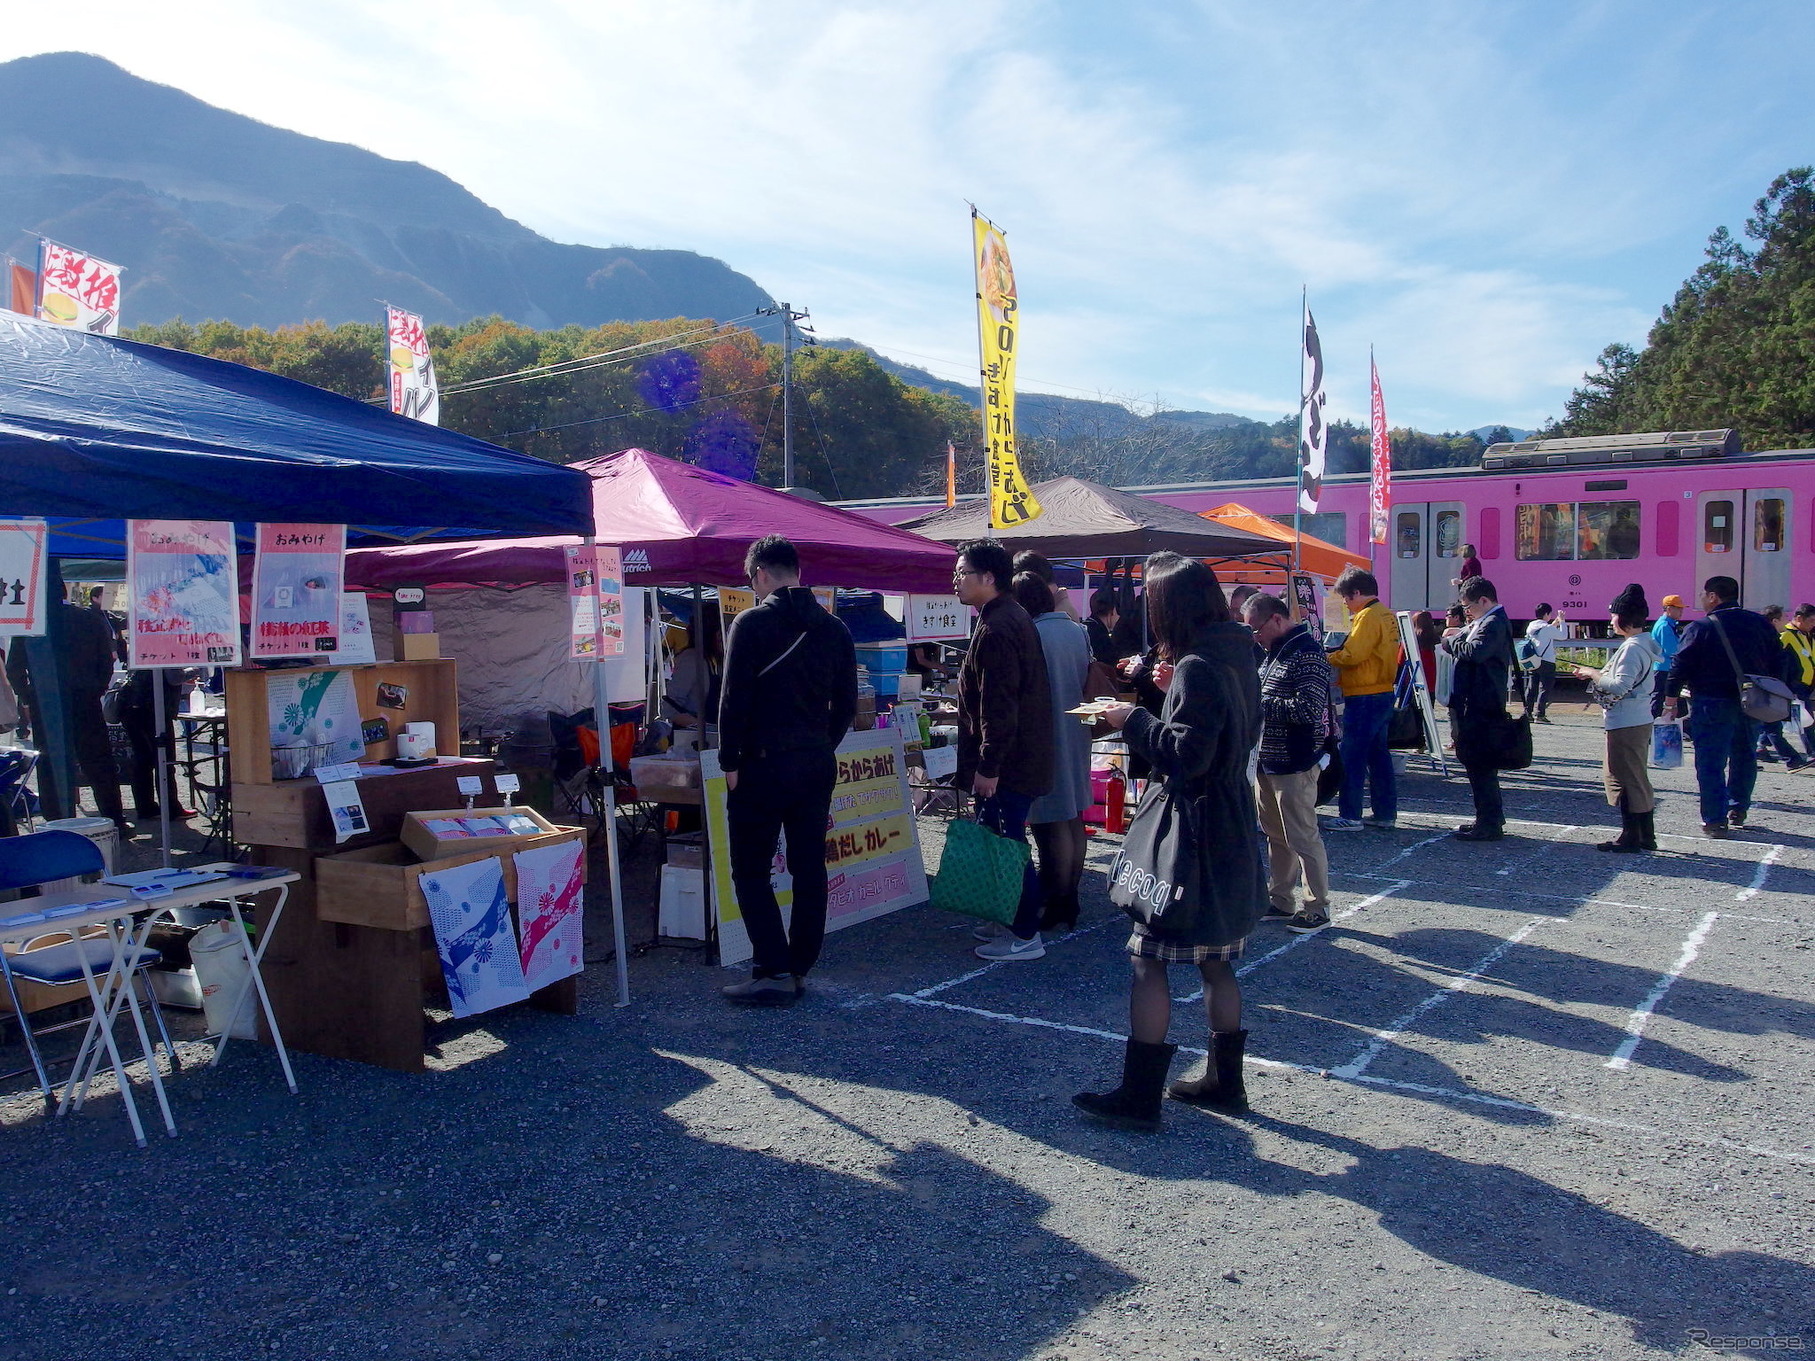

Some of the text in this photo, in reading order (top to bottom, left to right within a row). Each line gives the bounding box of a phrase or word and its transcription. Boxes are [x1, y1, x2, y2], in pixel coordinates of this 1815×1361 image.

[275, 533, 327, 546] おみやげ
[622, 563, 652, 573] utrich
[922, 613, 957, 629] きすけ食堂
[258, 642, 289, 650] チケット
[139, 651, 176, 659] チケット
